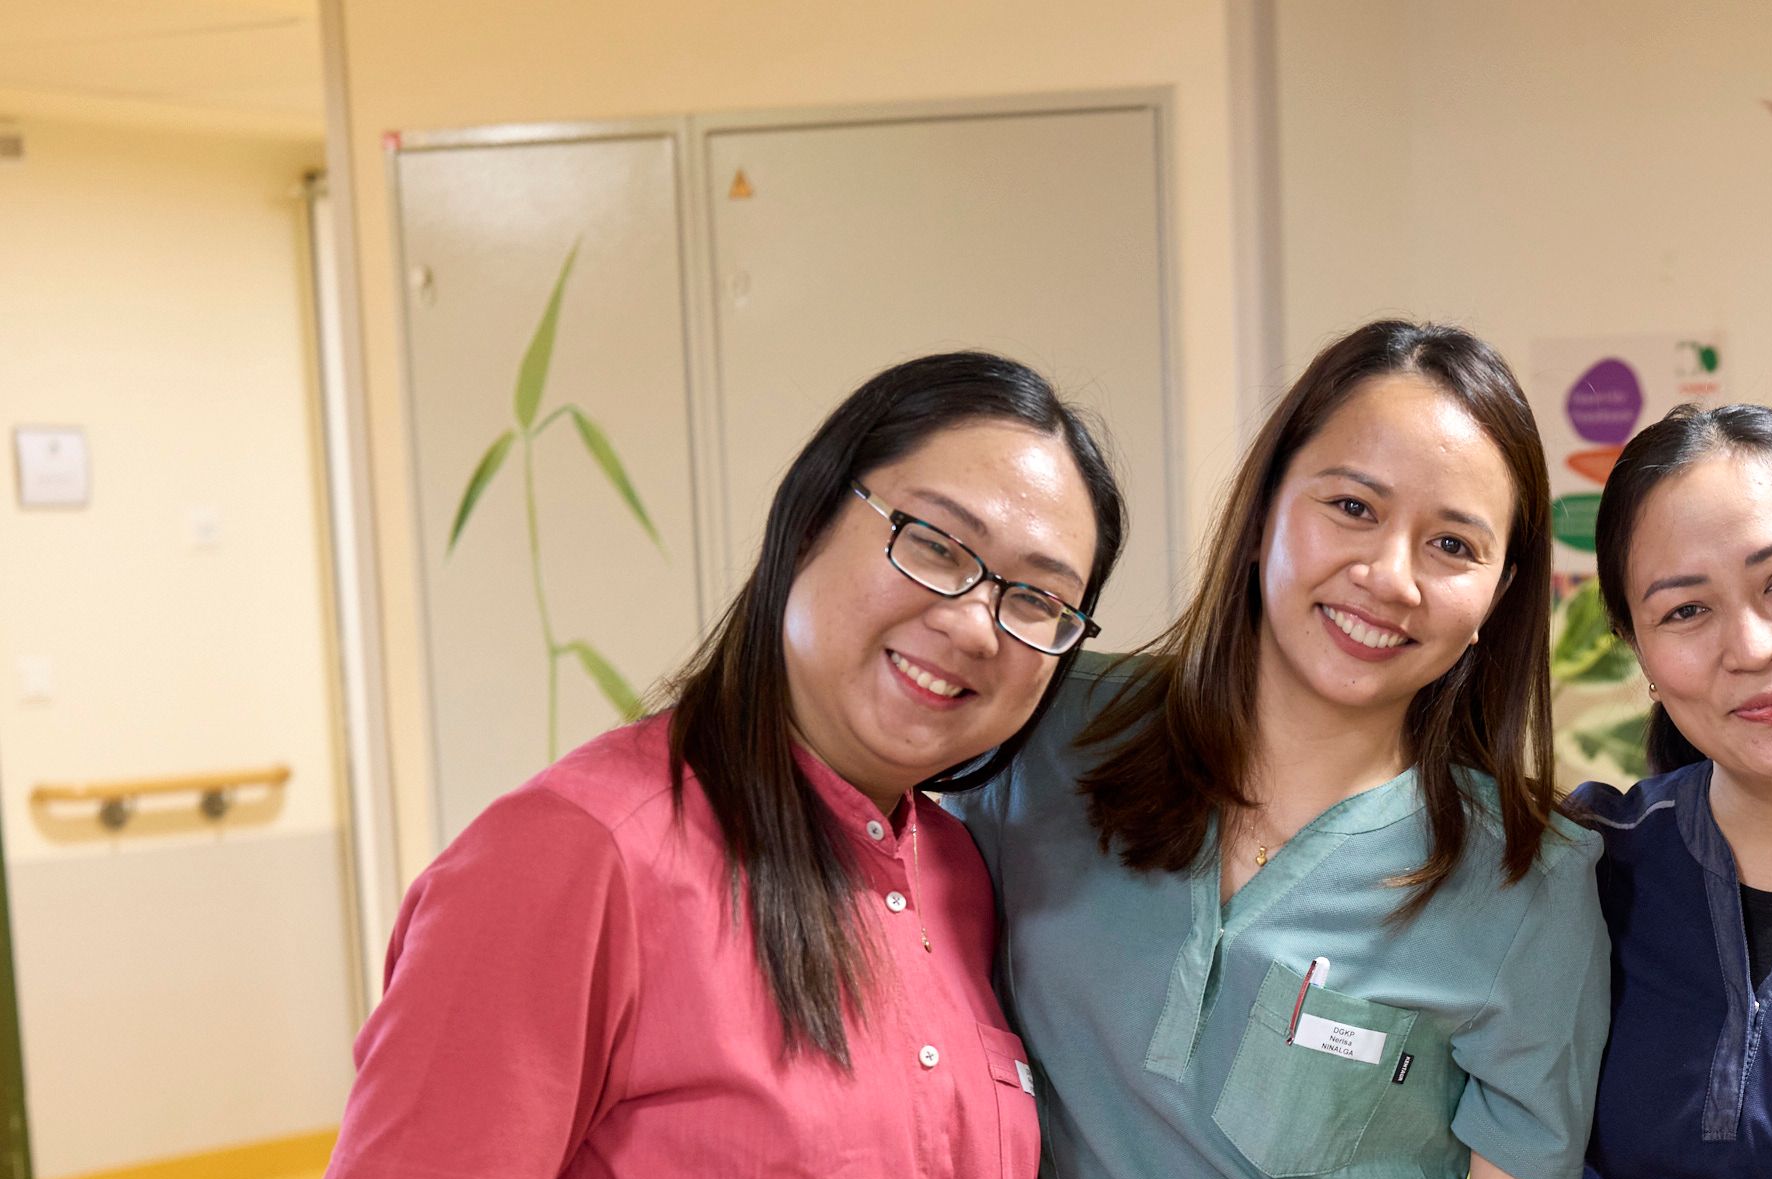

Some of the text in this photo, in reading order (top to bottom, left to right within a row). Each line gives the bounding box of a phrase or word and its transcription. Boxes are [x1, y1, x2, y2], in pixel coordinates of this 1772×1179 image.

[1333, 1026, 1355, 1037] DGKP
[1329, 1035, 1352, 1046] Nerisa
[1321, 1043, 1354, 1056] NINALGA
